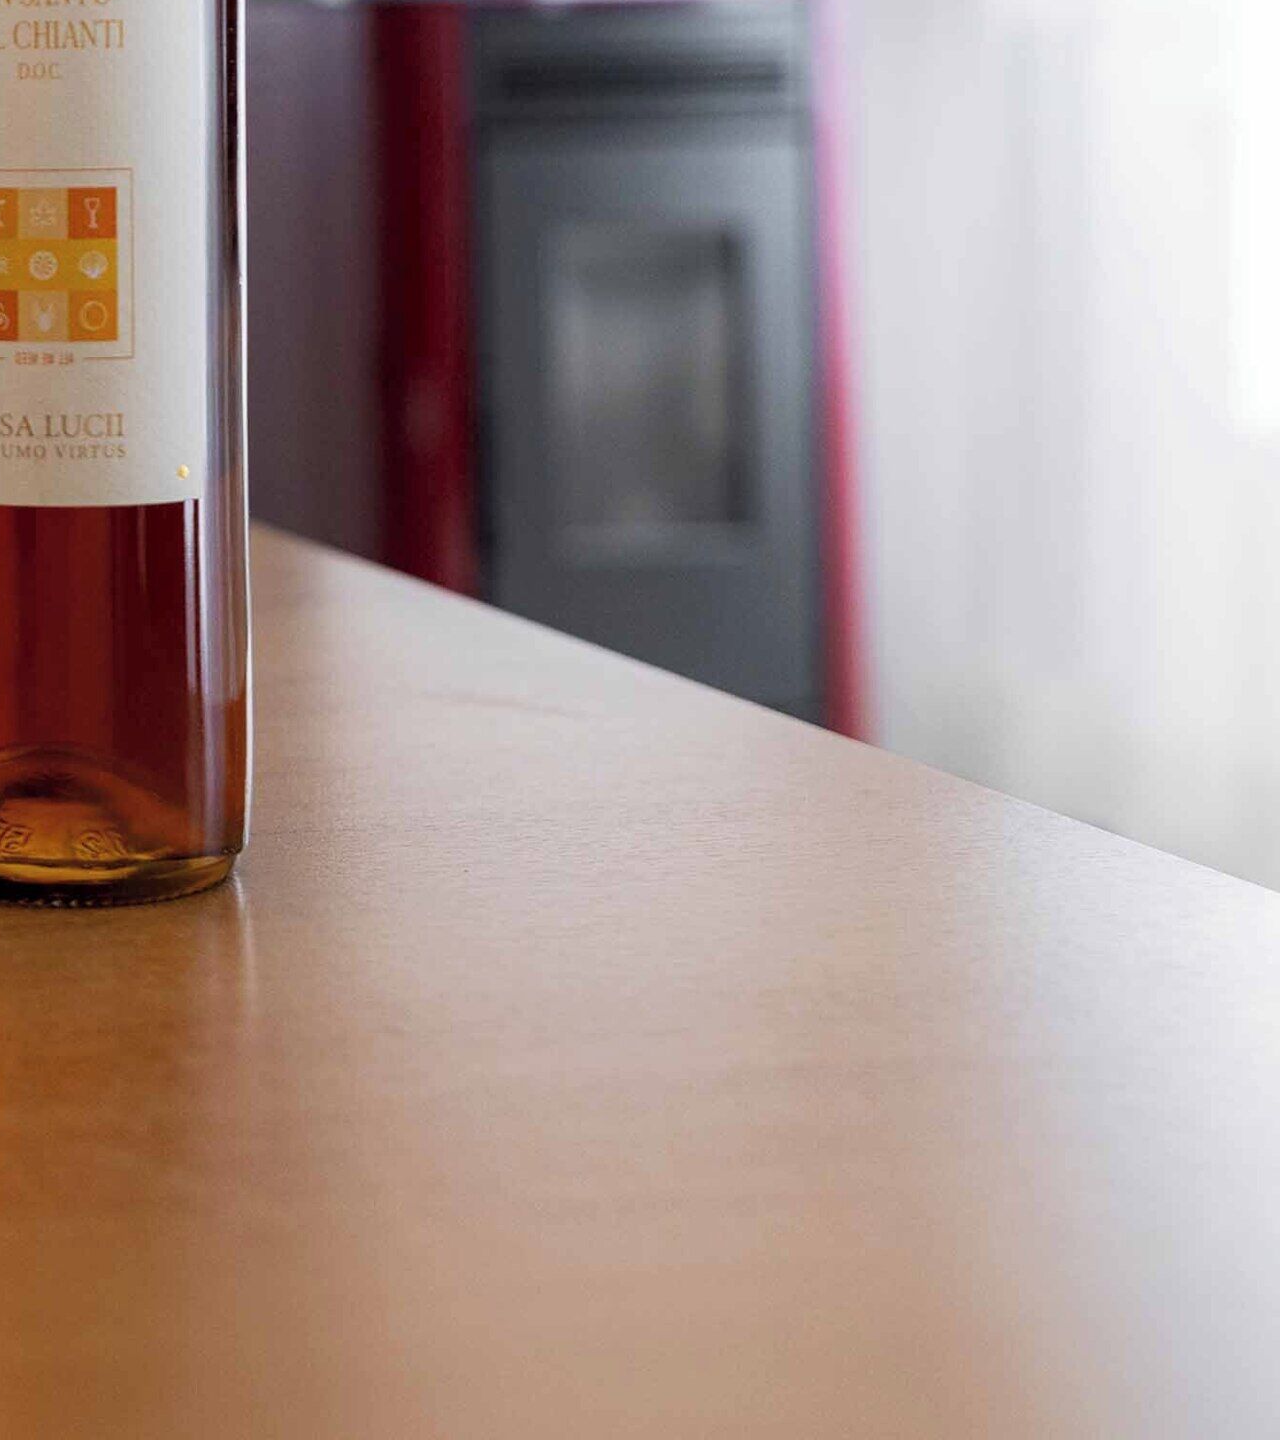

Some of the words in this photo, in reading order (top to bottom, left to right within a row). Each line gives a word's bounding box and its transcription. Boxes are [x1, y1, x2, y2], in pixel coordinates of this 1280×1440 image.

[12, 18, 125, 50] CHIANTI
[44, 412, 126, 438] LUCII
[53, 443, 127, 459] VIRTUS
